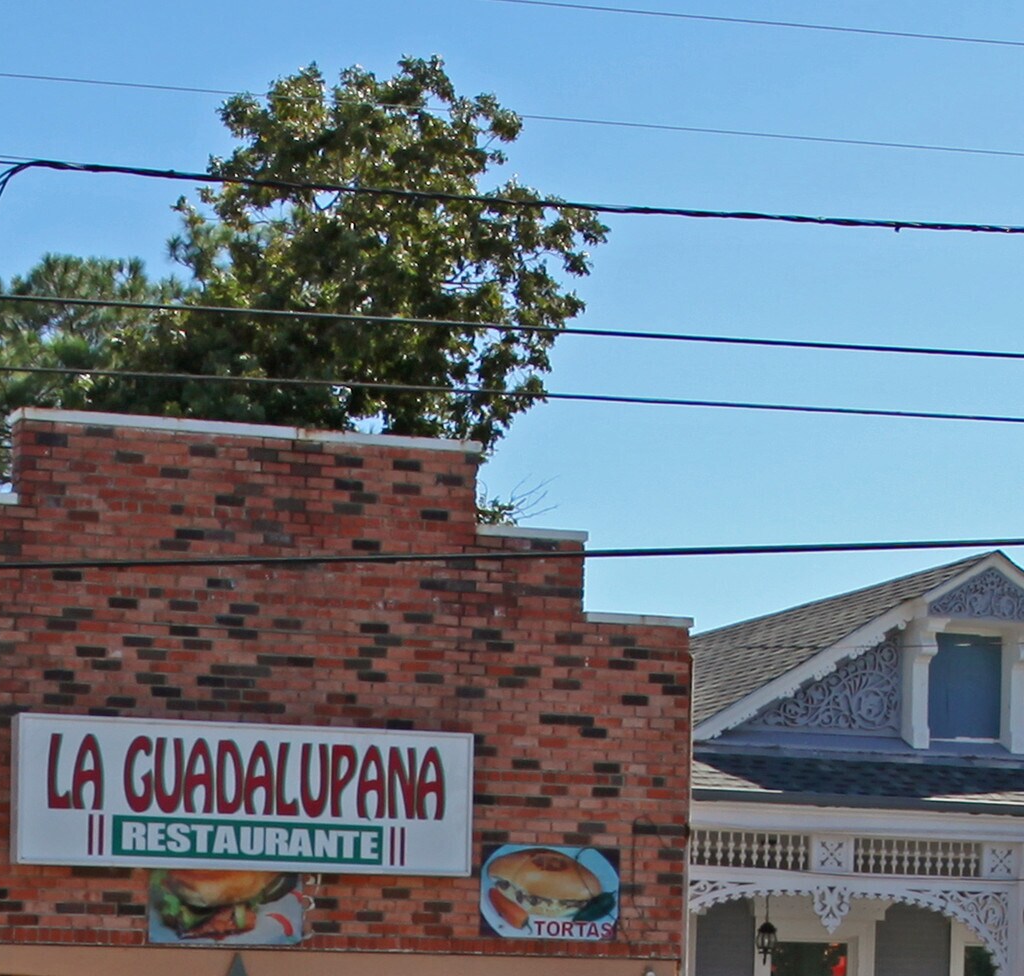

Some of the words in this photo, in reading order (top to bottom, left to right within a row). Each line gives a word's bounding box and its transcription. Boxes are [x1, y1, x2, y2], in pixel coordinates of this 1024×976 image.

[47, 732, 104, 811] LA
[123, 734, 446, 821] GUADALUPANA
[121, 820, 379, 861] RESTAURANTE
[533, 920, 614, 938] TORTAS
